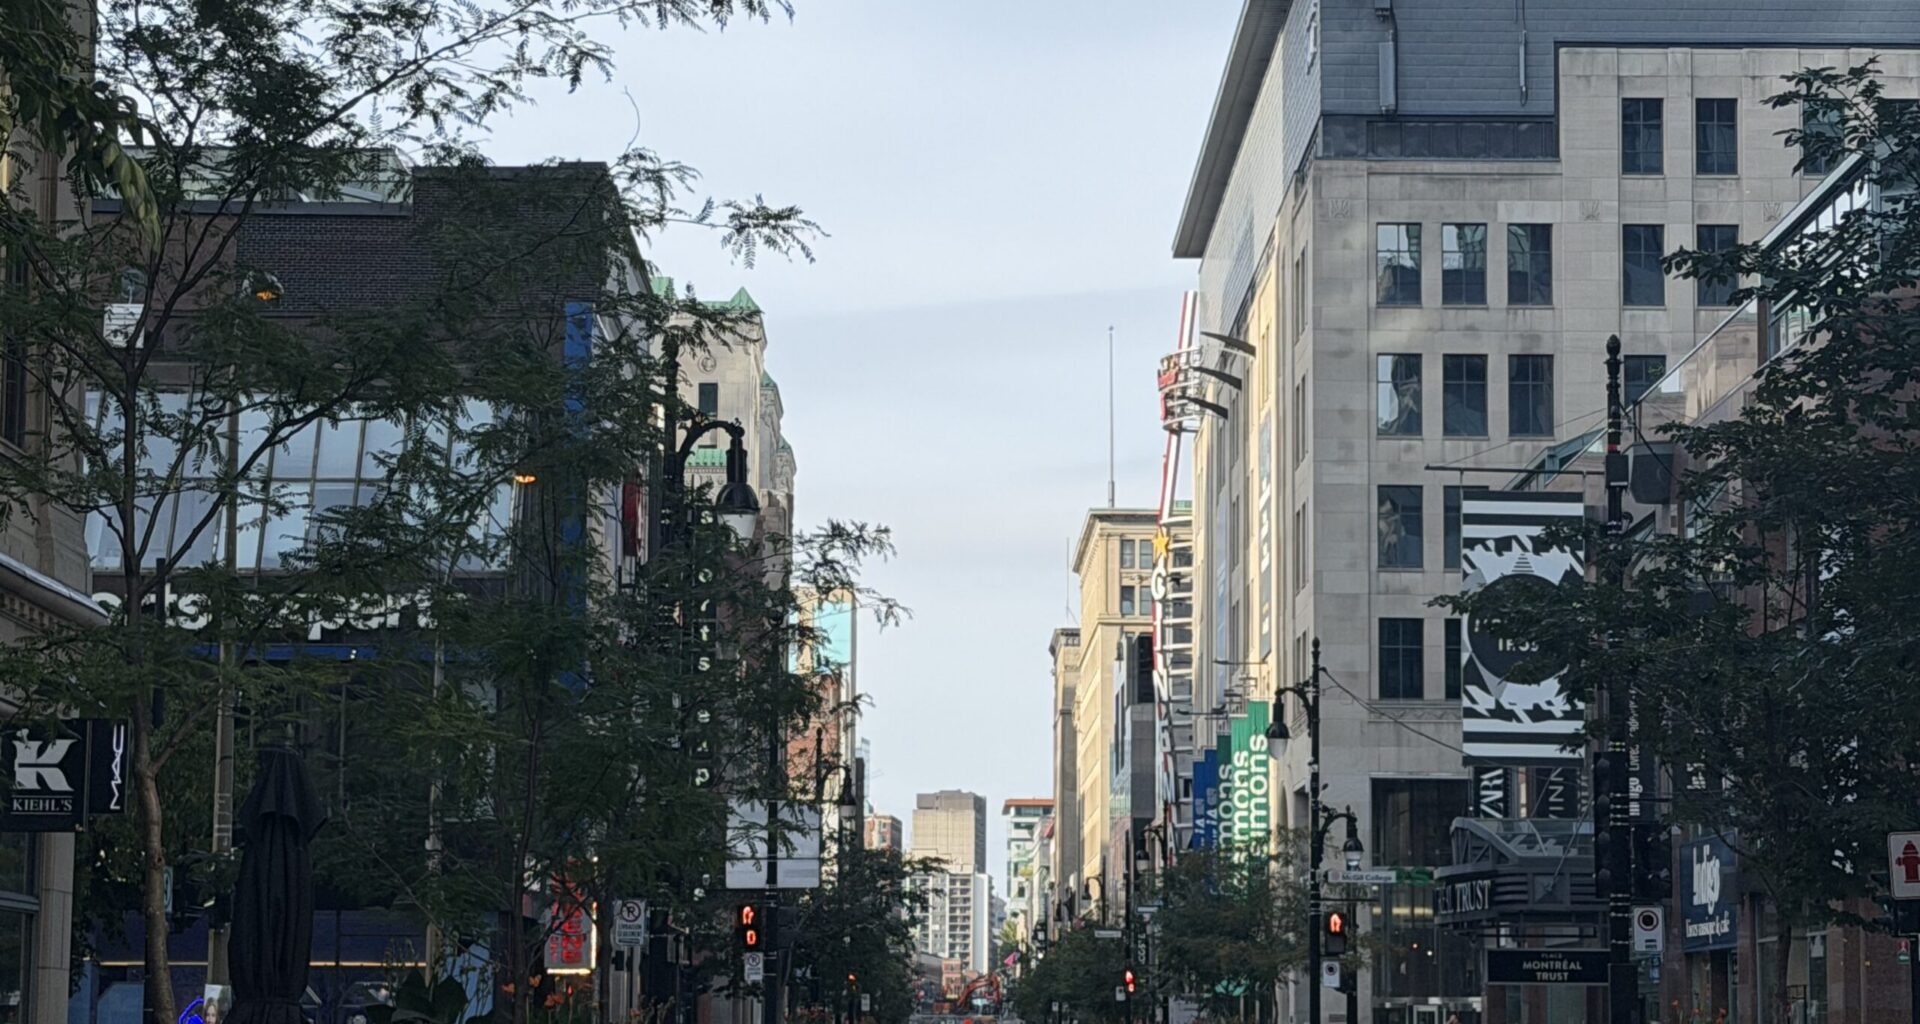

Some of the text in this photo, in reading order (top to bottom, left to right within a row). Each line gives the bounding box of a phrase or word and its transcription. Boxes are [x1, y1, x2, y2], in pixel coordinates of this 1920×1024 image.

[12, 798, 73, 812] KIEHL'S
[1250, 734, 1268, 857] simons
[1480, 768, 1504, 819] ZARA
[1218, 763, 1233, 866] mons
[1365, 873, 1392, 882] College
[1455, 879, 1492, 912] TRUST
[1522, 959, 1583, 970] MONTRÉAL
[1535, 972, 1569, 981] TRUST
